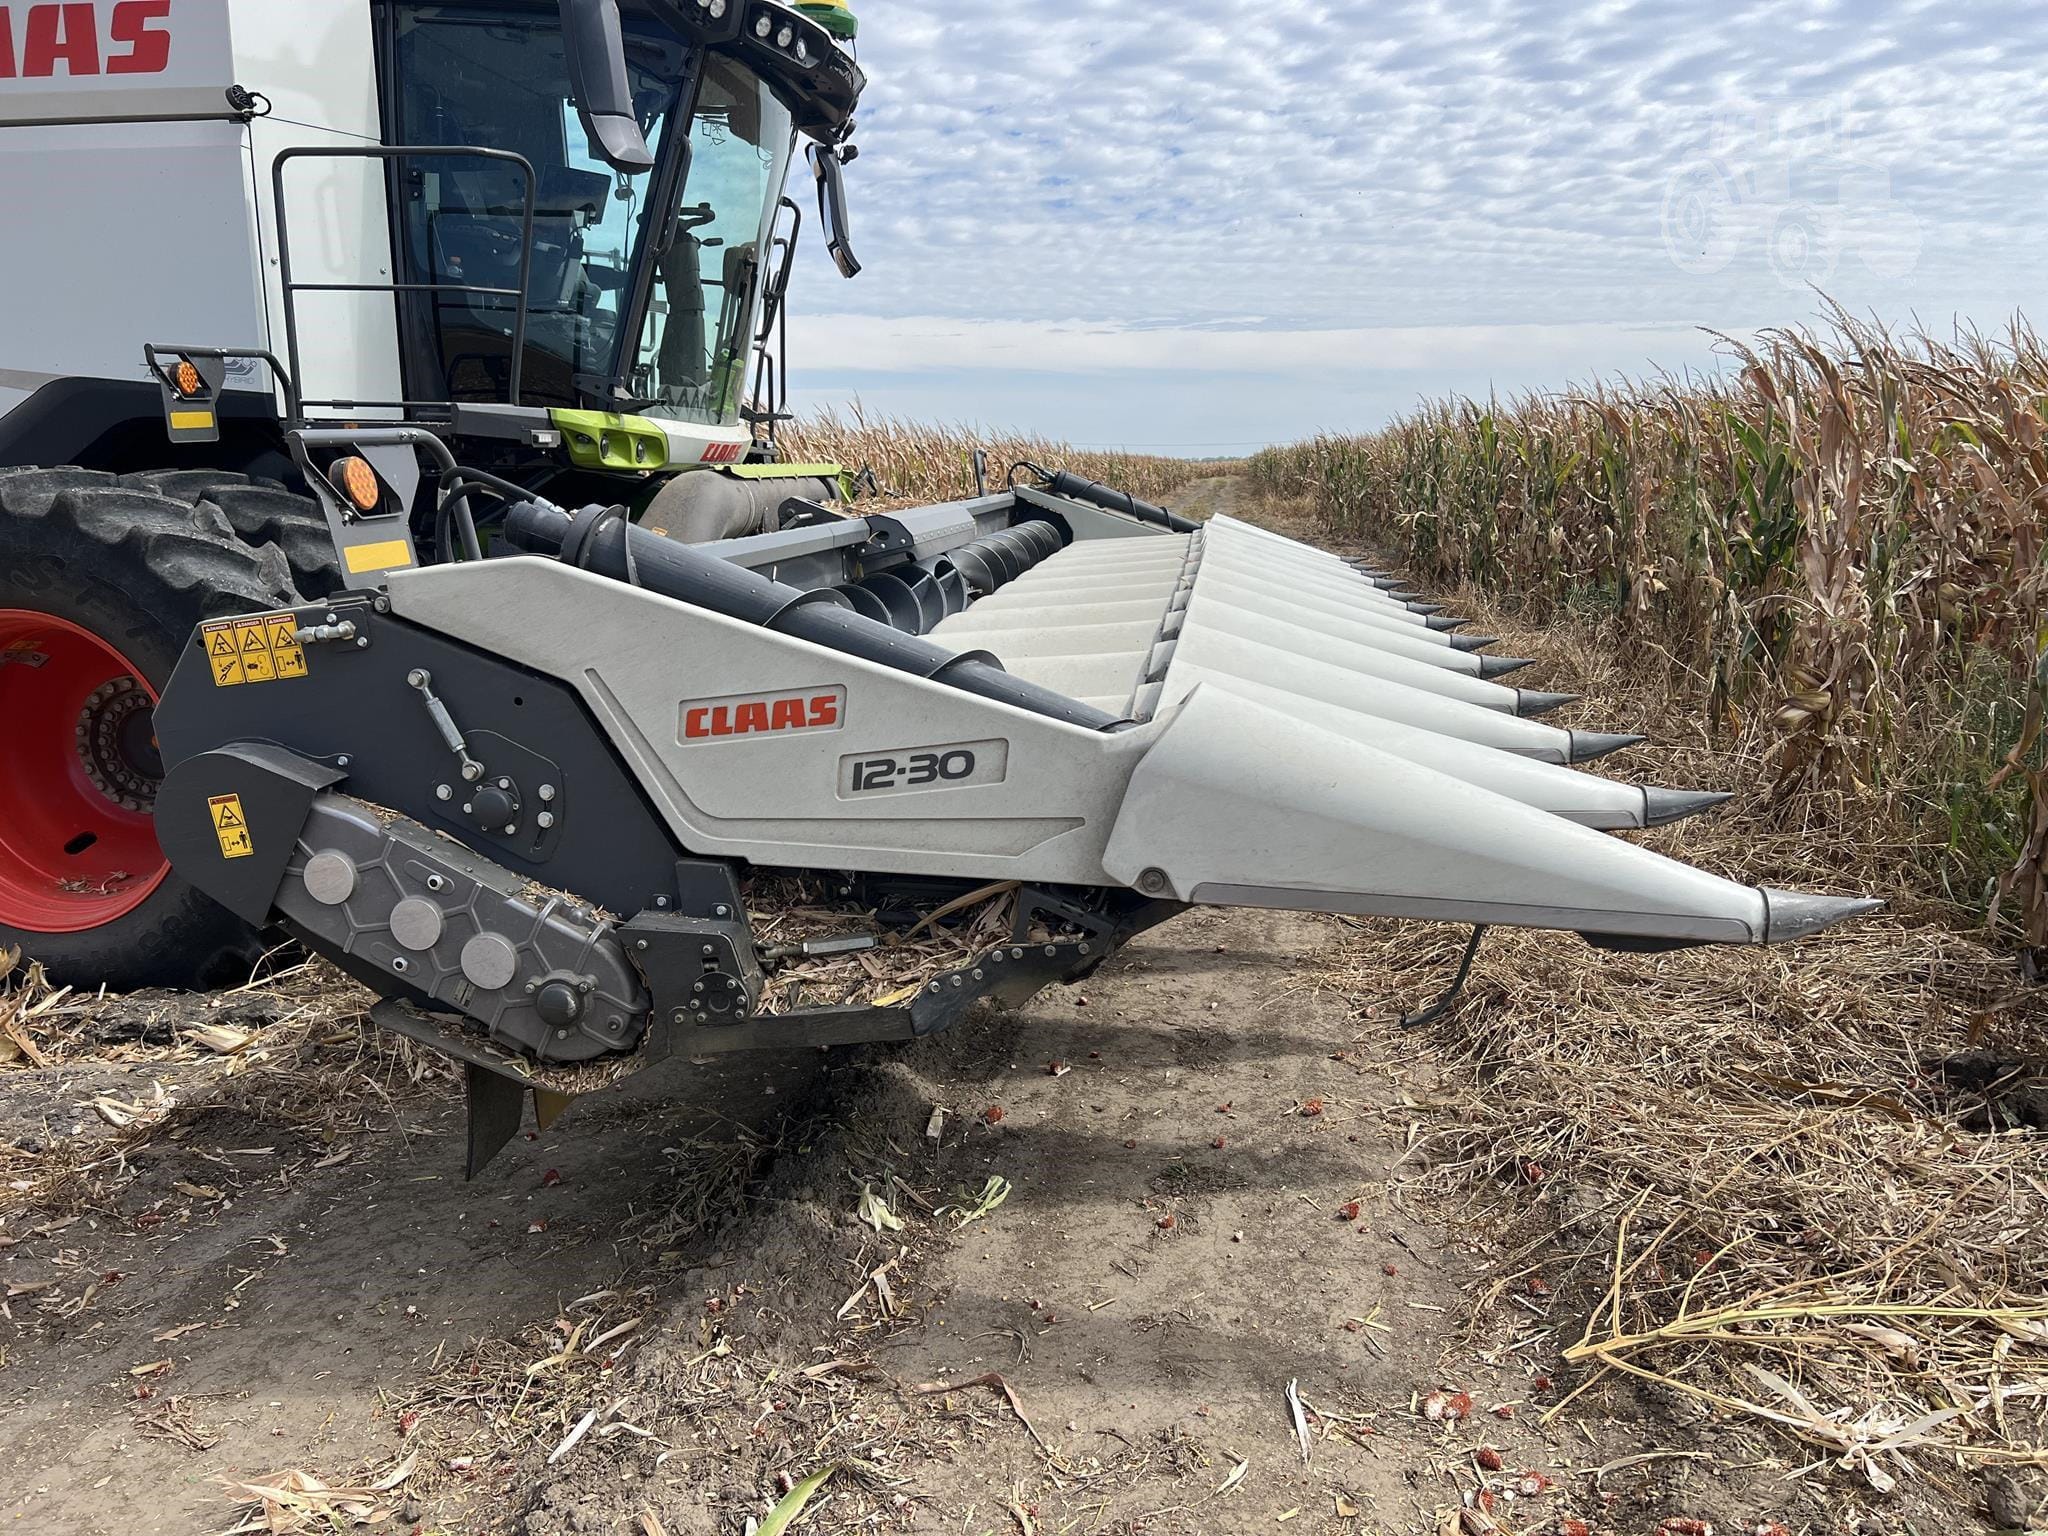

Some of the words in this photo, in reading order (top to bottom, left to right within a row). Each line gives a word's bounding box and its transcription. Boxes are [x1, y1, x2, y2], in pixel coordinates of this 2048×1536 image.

[0, 0, 170, 78] AS
[700, 443, 742, 462] CLAAS
[685, 695, 837, 738] CLAAS
